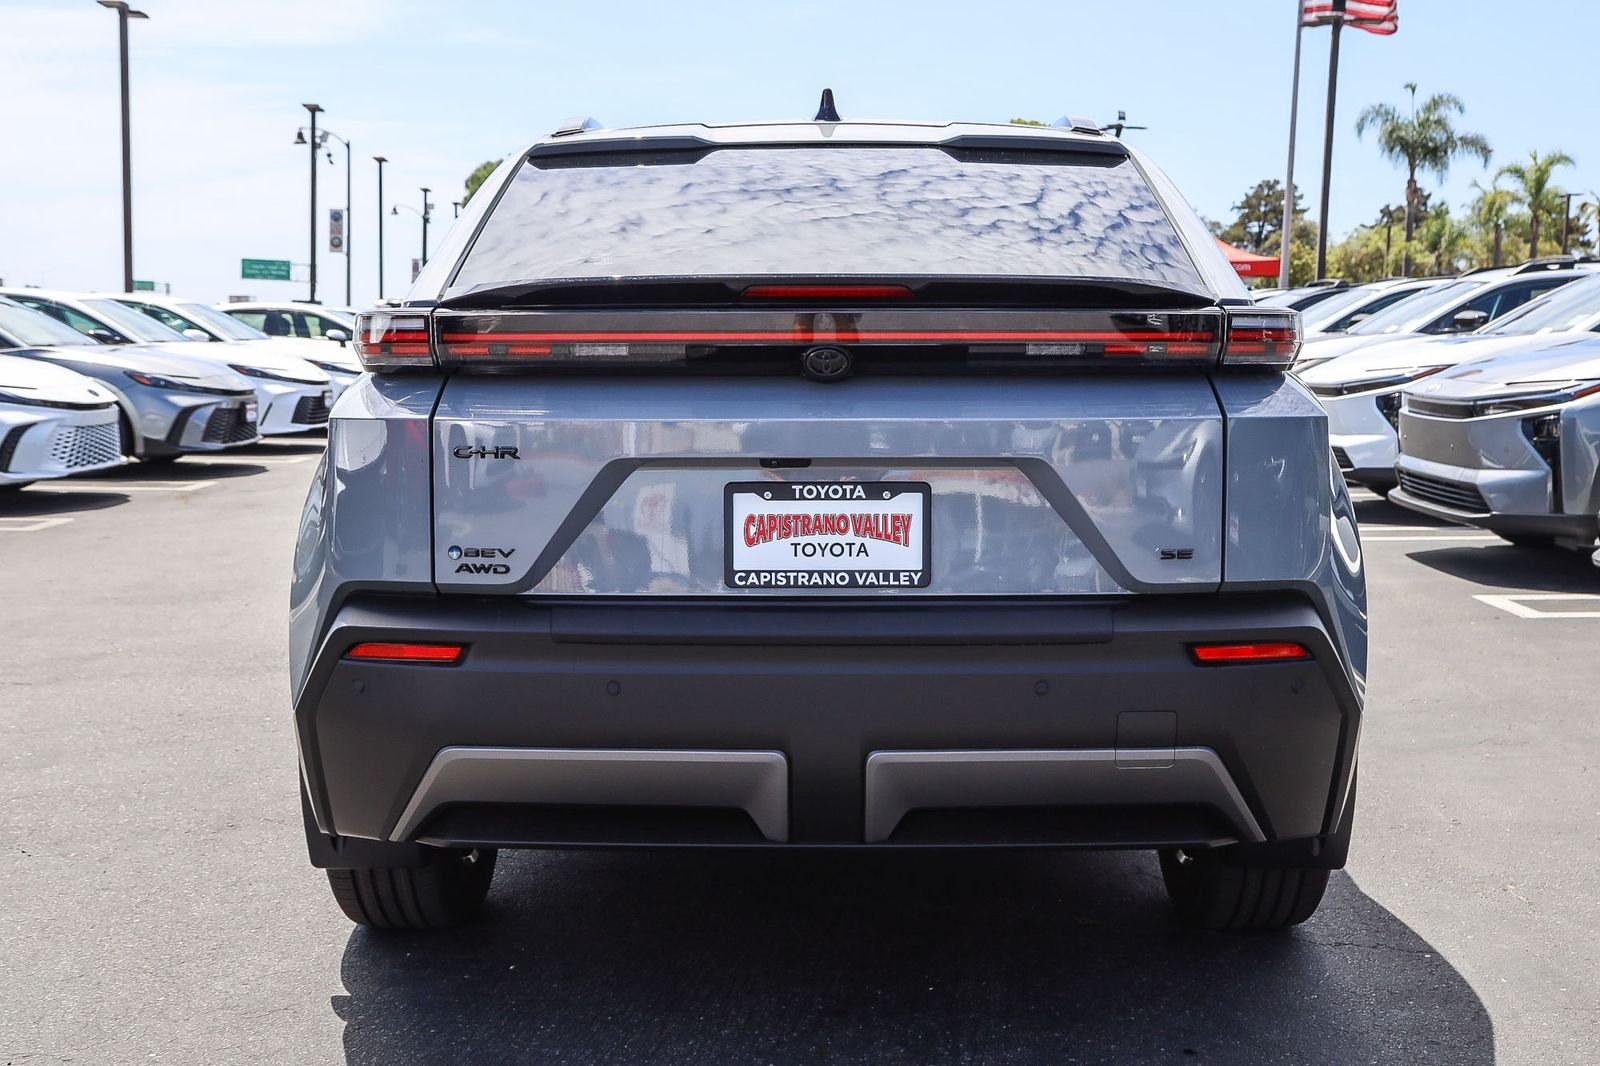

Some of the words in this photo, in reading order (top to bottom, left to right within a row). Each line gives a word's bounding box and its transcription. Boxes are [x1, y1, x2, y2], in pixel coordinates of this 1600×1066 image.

[453, 446, 520, 459] C-HR
[792, 485, 866, 499] TOYOTA
[744, 513, 849, 547] CAPISTRANO
[851, 513, 913, 547] VALLEY
[463, 548, 516, 558] BEV
[791, 543, 869, 557] TOYOTA
[1160, 548, 1194, 560] SE
[454, 563, 511, 574] AWD
[734, 573, 849, 585] CAPISTRANO
[855, 573, 922, 585] VALLEY
